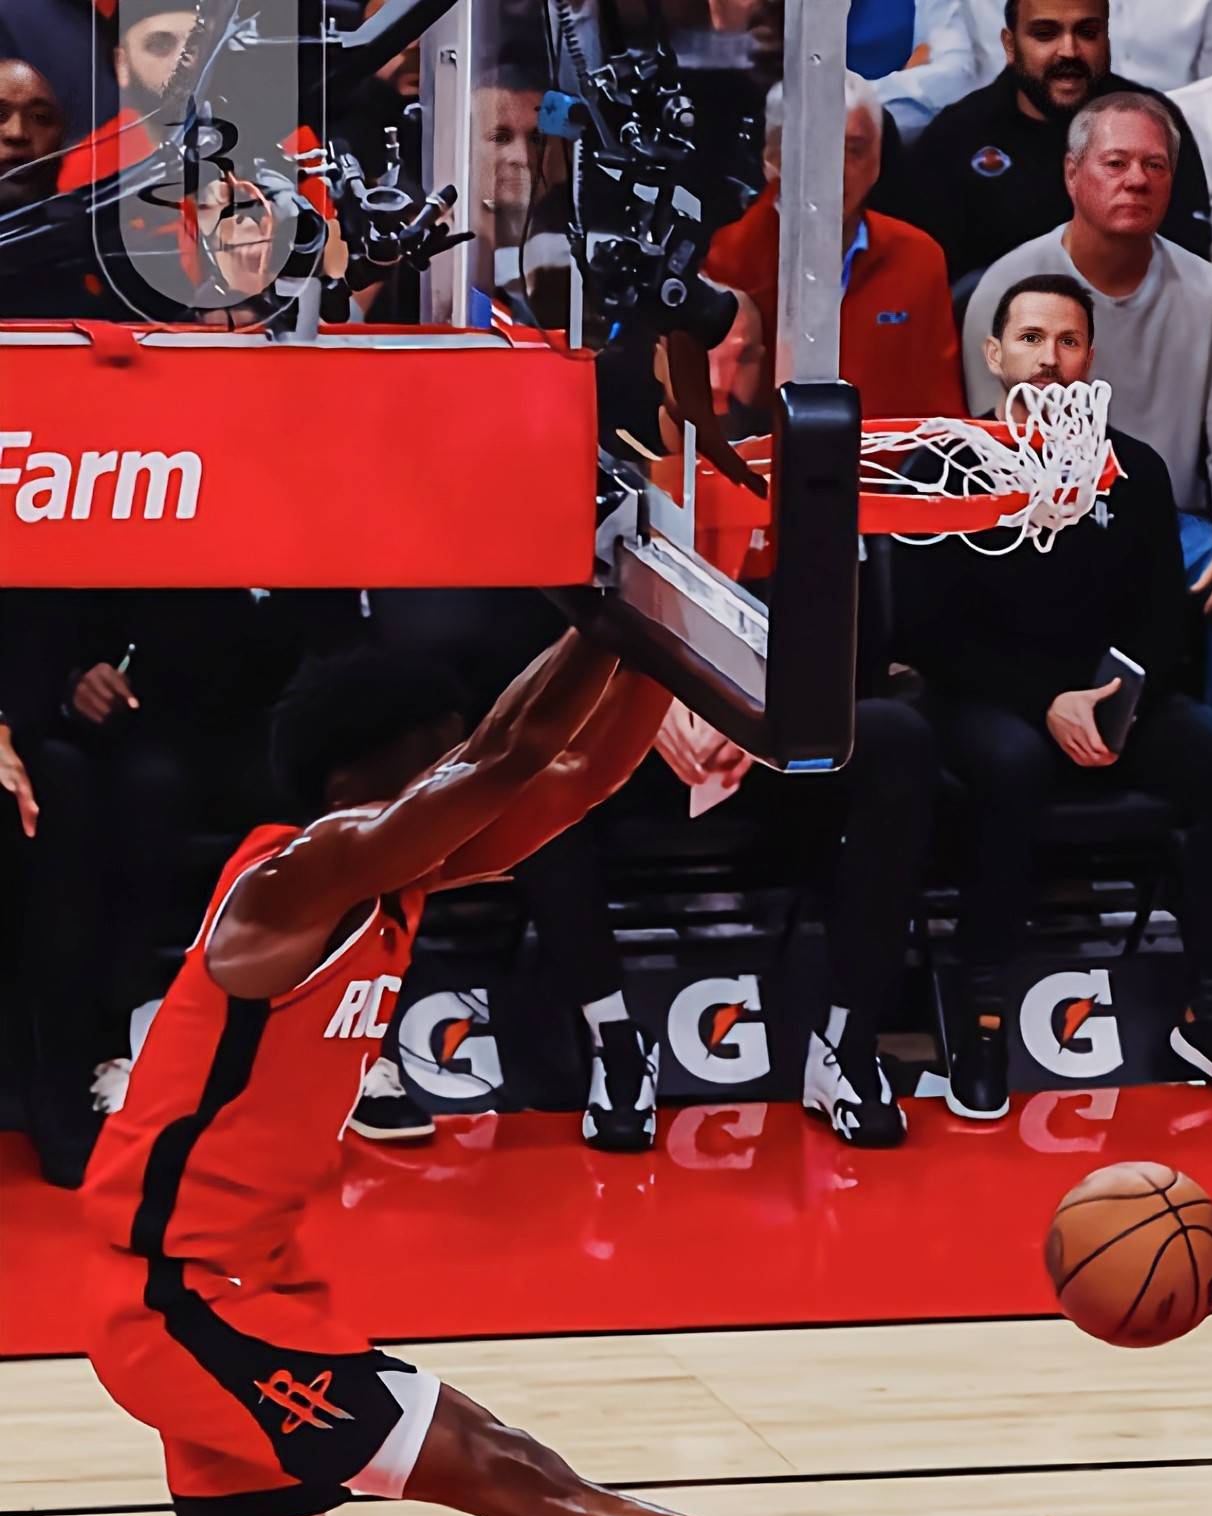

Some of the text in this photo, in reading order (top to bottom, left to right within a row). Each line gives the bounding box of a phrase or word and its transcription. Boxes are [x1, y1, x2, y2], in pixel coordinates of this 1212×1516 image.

[398, 988, 504, 1099] G
[667, 974, 770, 1084] G
[1019, 969, 1124, 1078] G
